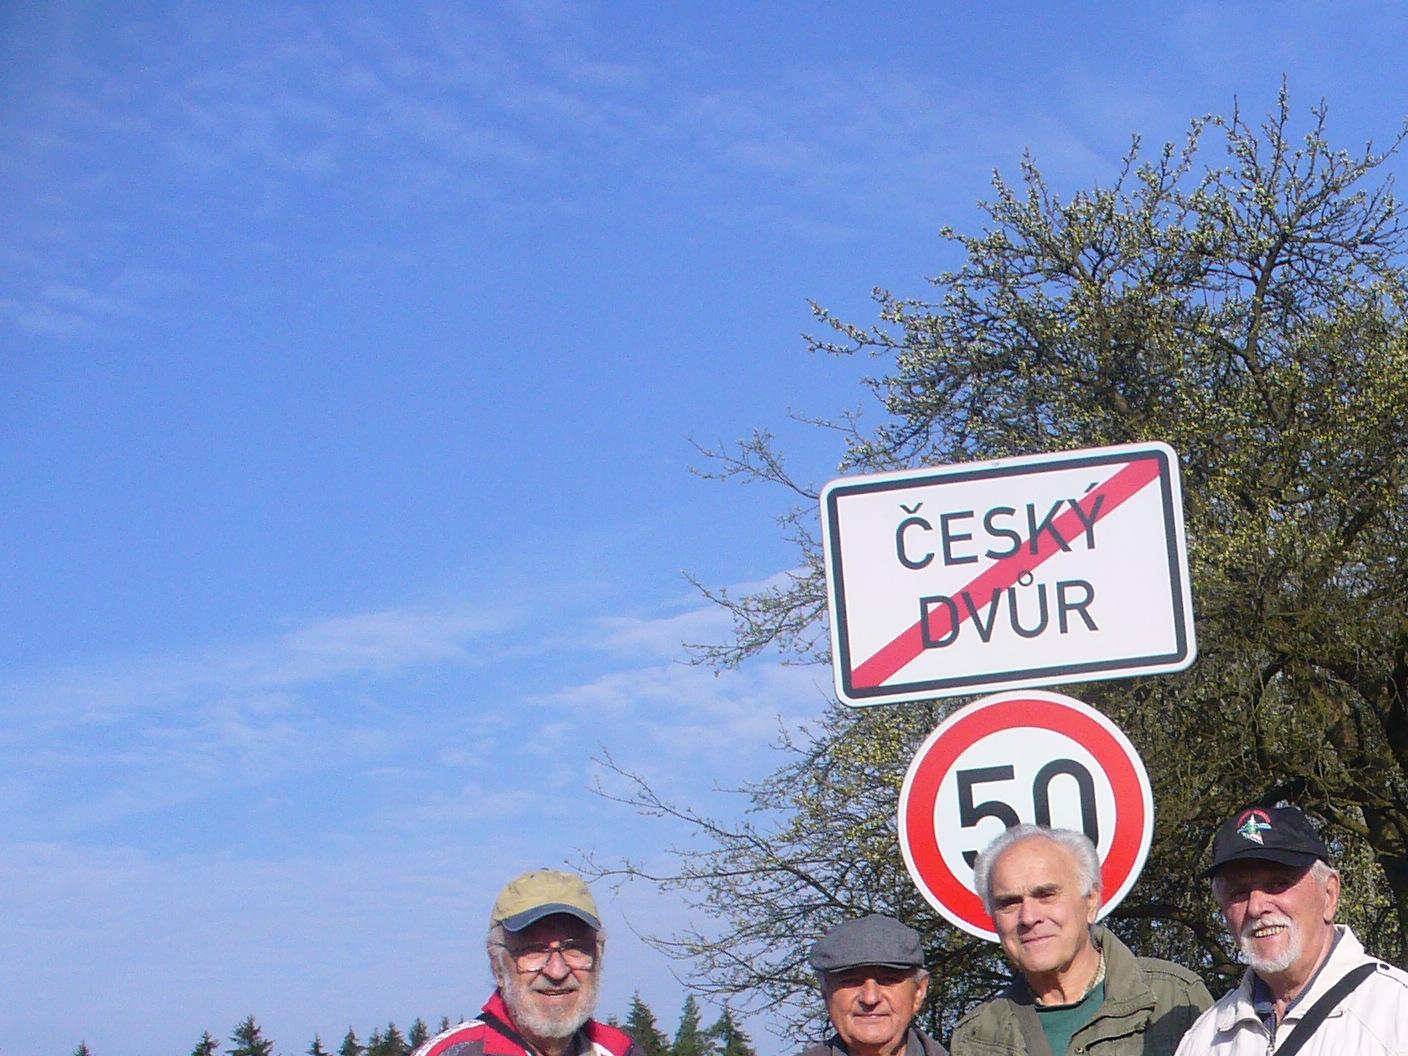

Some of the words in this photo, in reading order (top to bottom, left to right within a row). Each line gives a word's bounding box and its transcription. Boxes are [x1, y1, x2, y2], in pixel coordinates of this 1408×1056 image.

[895, 482, 1105, 570] ČESKÝ
[919, 569, 1099, 649] DVŮR
[956, 758, 1099, 870] 50
